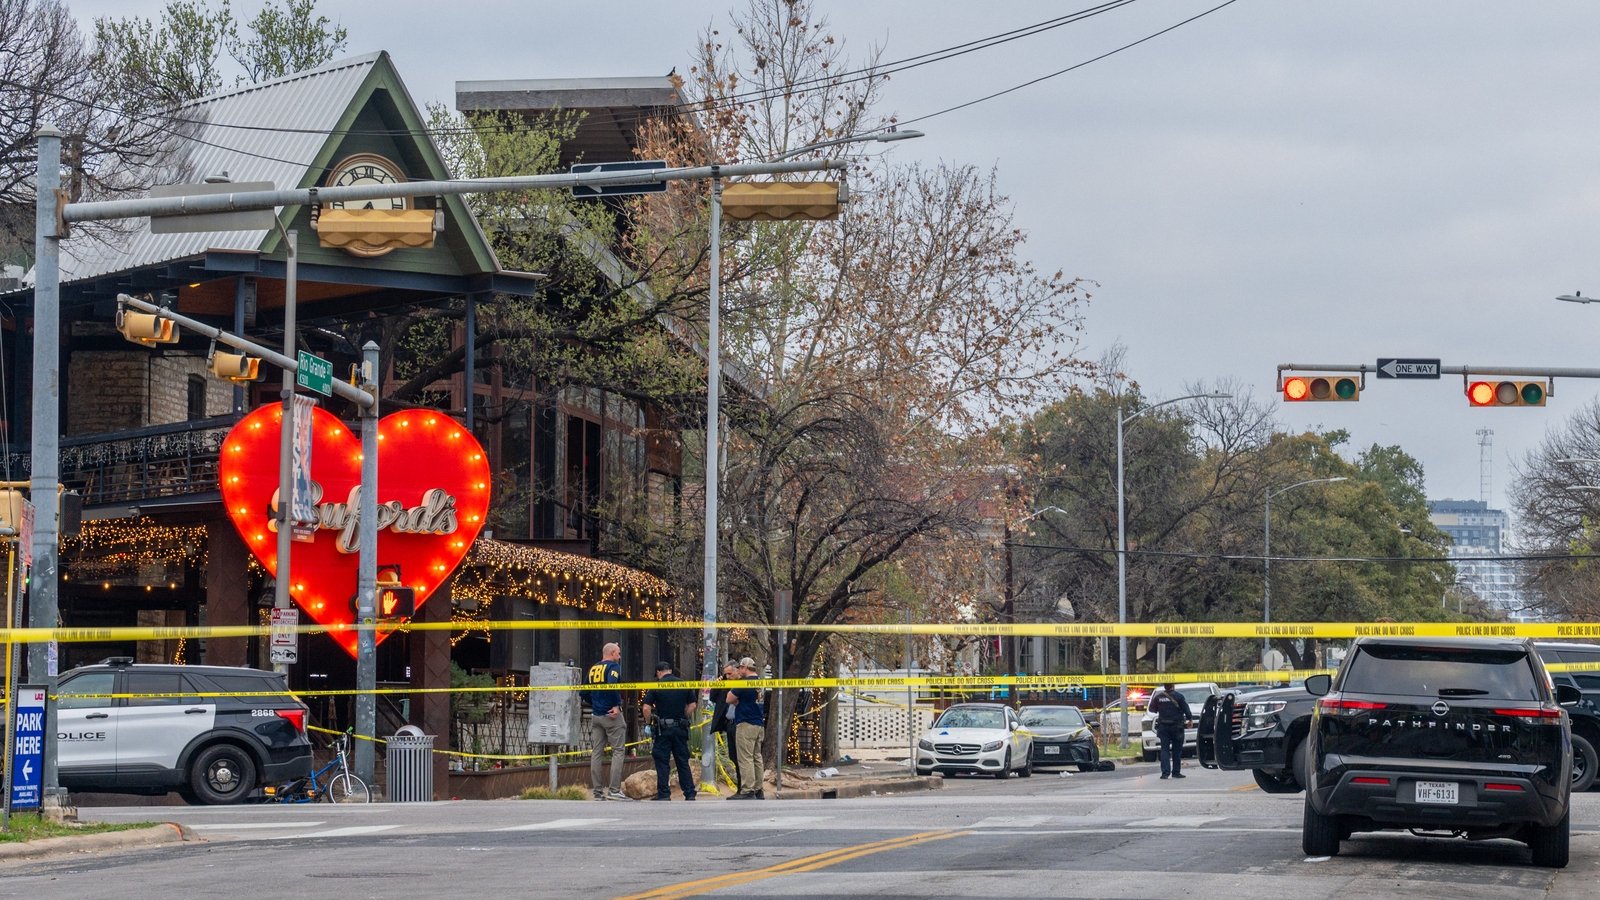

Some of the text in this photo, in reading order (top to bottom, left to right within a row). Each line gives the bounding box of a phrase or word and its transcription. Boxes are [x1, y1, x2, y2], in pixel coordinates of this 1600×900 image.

[300, 354, 308, 372] Rio
[310, 357, 326, 379] Grande
[1256, 626, 1314, 635] POLICE LINE DO NOT CROSS
[1355, 626, 1414, 635] POLICE LINE DO NOT CROSS
[1456, 626, 1515, 635] POLICE LINE DO NOT CROSS
[1558, 626, 1572, 635] POLICE
[1574, 626, 1583, 635] LINE
[1585, 626, 1591, 635] DO
[588, 664, 607, 684] FBI
[16, 713, 42, 731] PARK
[1369, 718, 1510, 732] PATHFINDER
[16, 736, 41, 755] HERE
